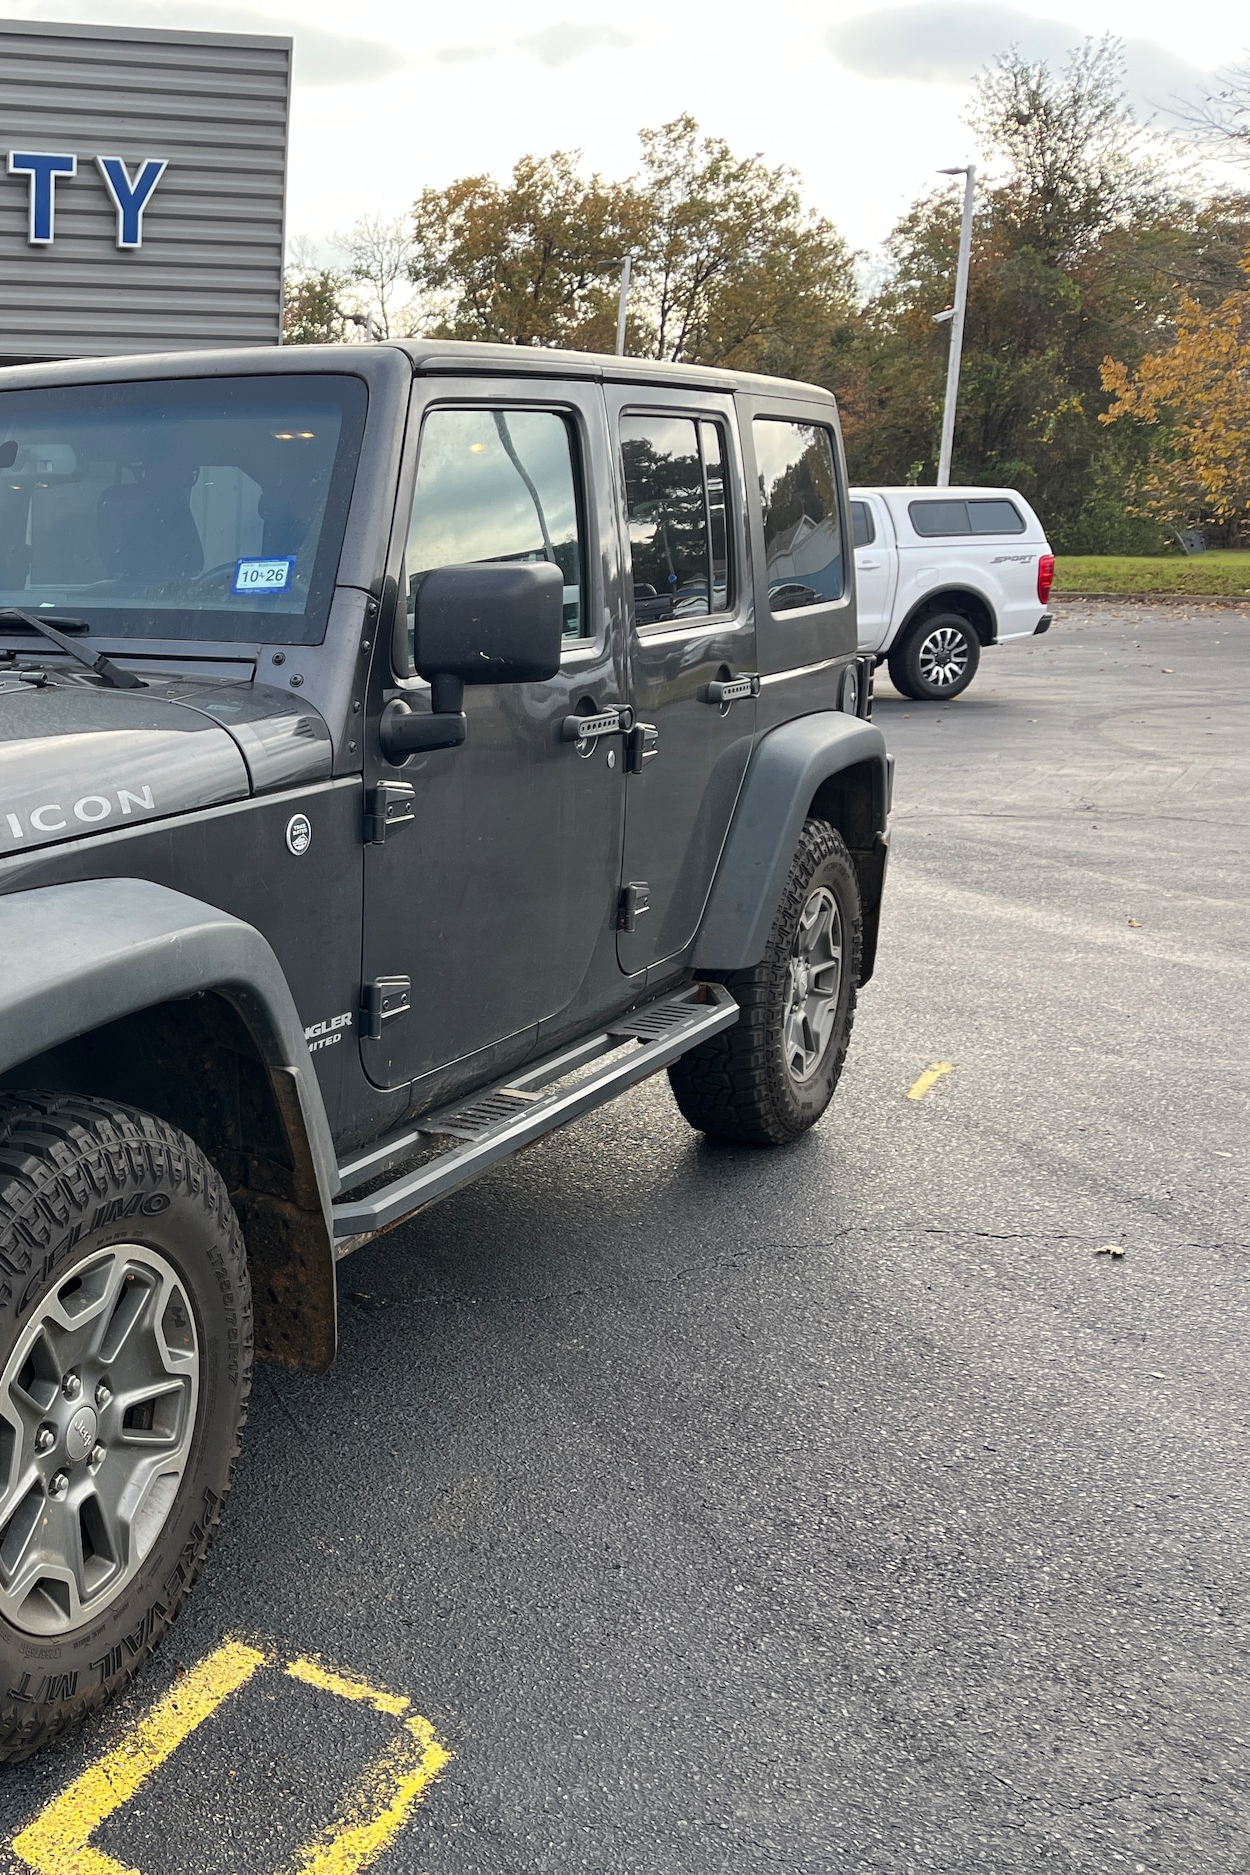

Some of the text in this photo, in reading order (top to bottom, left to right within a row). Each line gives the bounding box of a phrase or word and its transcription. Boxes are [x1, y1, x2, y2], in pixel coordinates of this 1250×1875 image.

[990, 554, 1037, 564] SPORT
[74, 1419, 92, 1447] Jeep
[90, 1485, 220, 1685] PREVAIL
[7, 1669, 80, 1706] M/T
